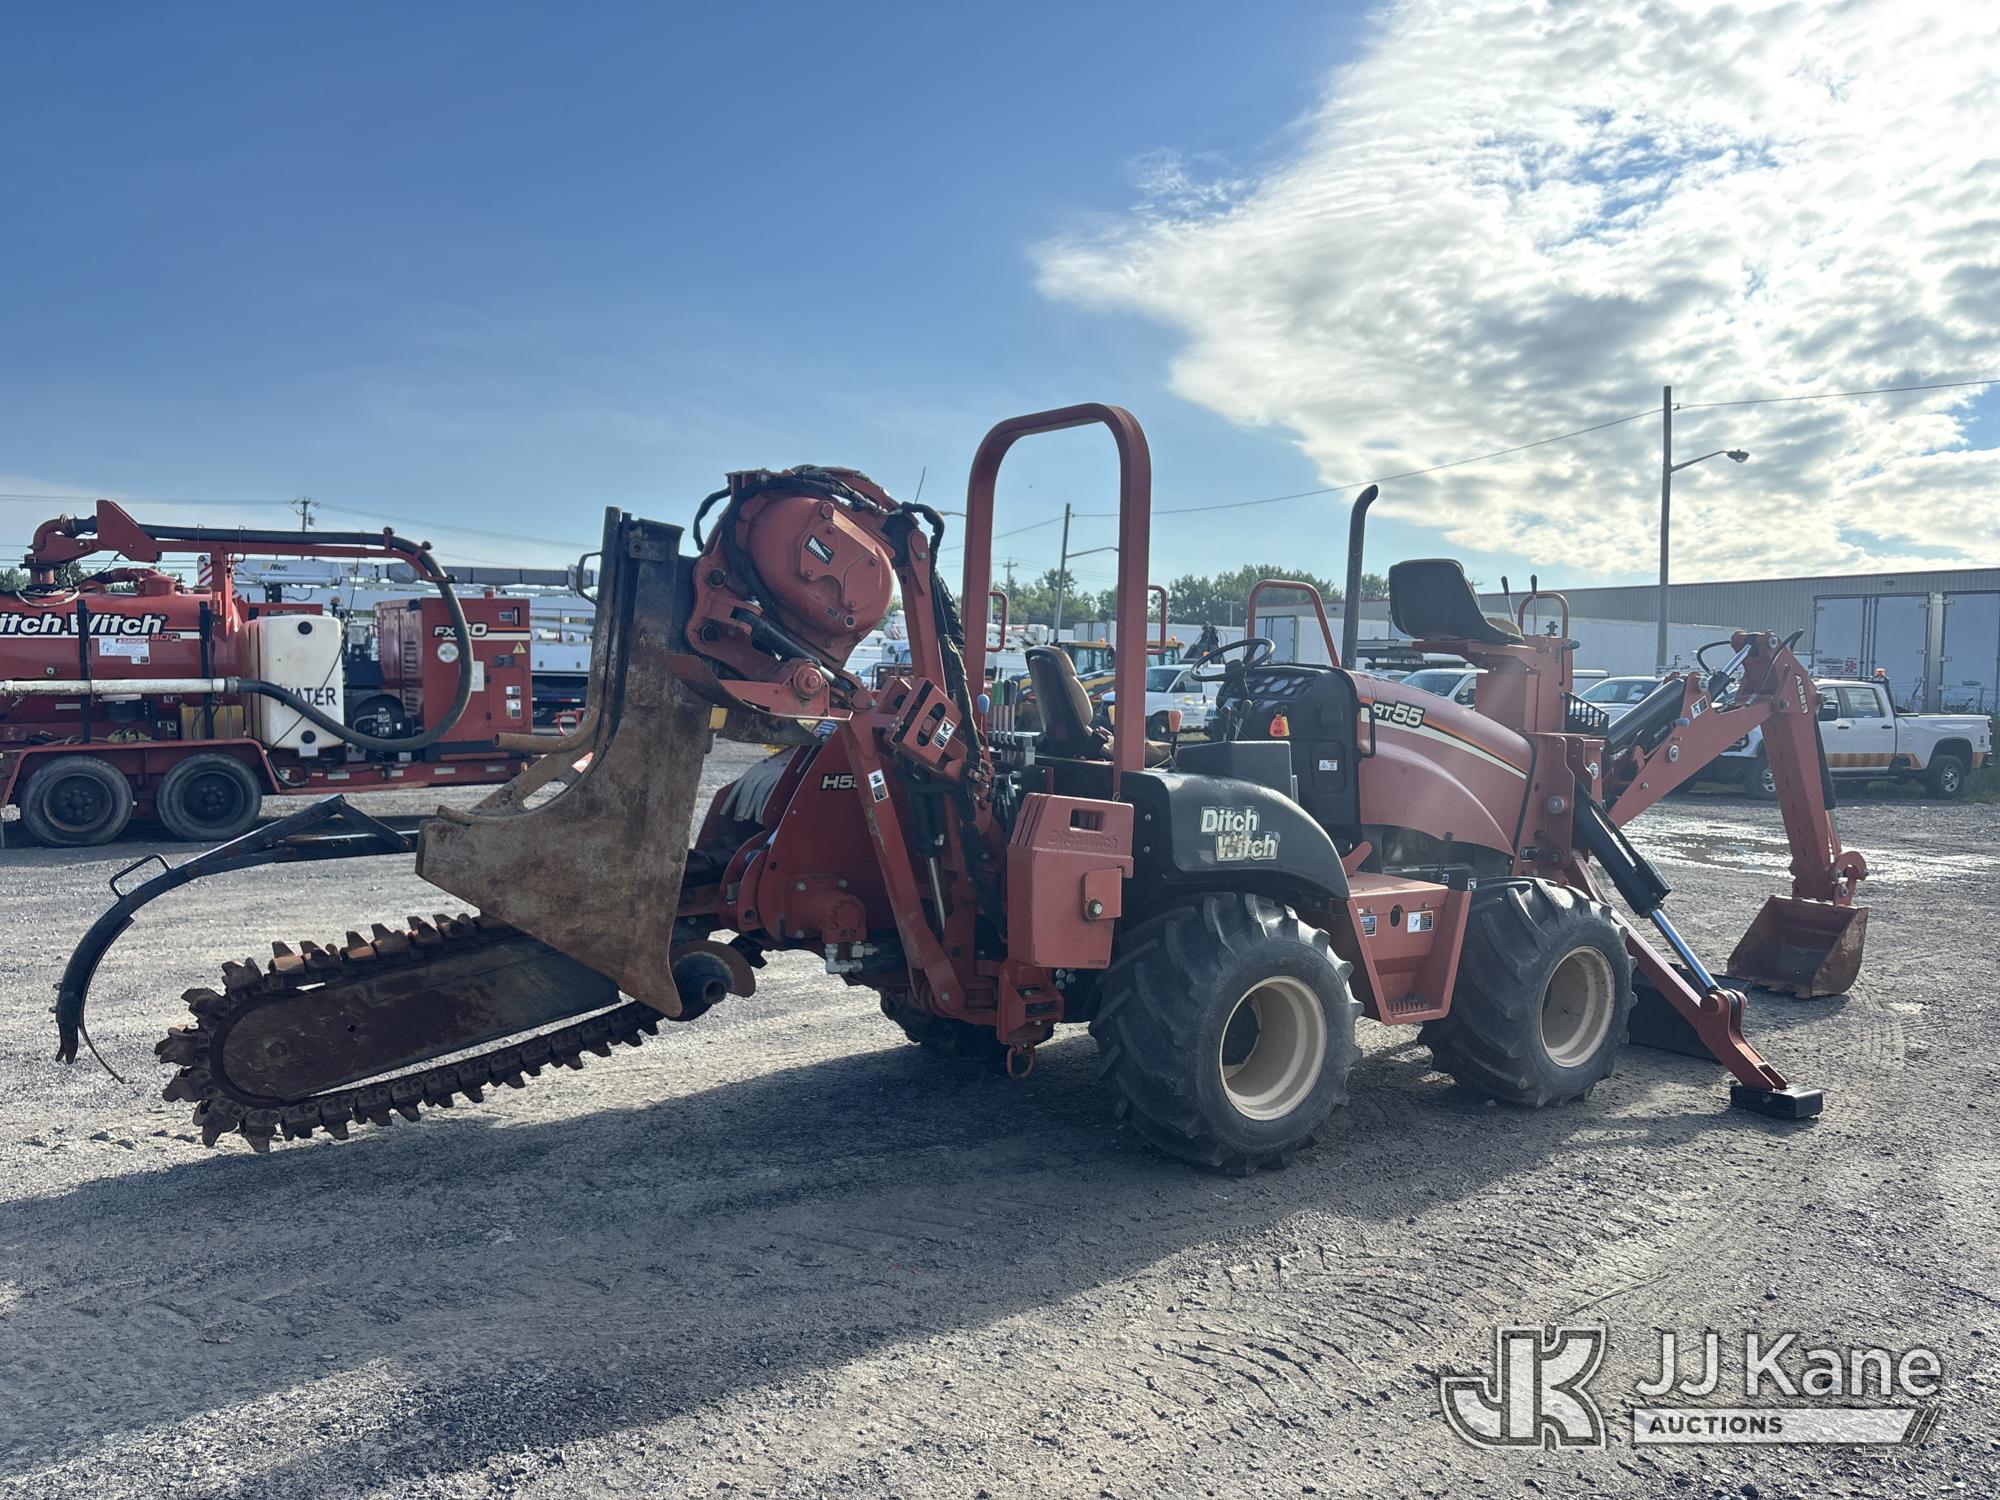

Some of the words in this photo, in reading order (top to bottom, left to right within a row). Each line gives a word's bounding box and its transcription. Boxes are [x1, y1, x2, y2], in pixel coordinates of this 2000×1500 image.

[0, 613, 62, 633] itch
[280, 687, 337, 706] ATER
[1373, 703, 1423, 726] RT55
[1201, 808, 1258, 833] Ditch
